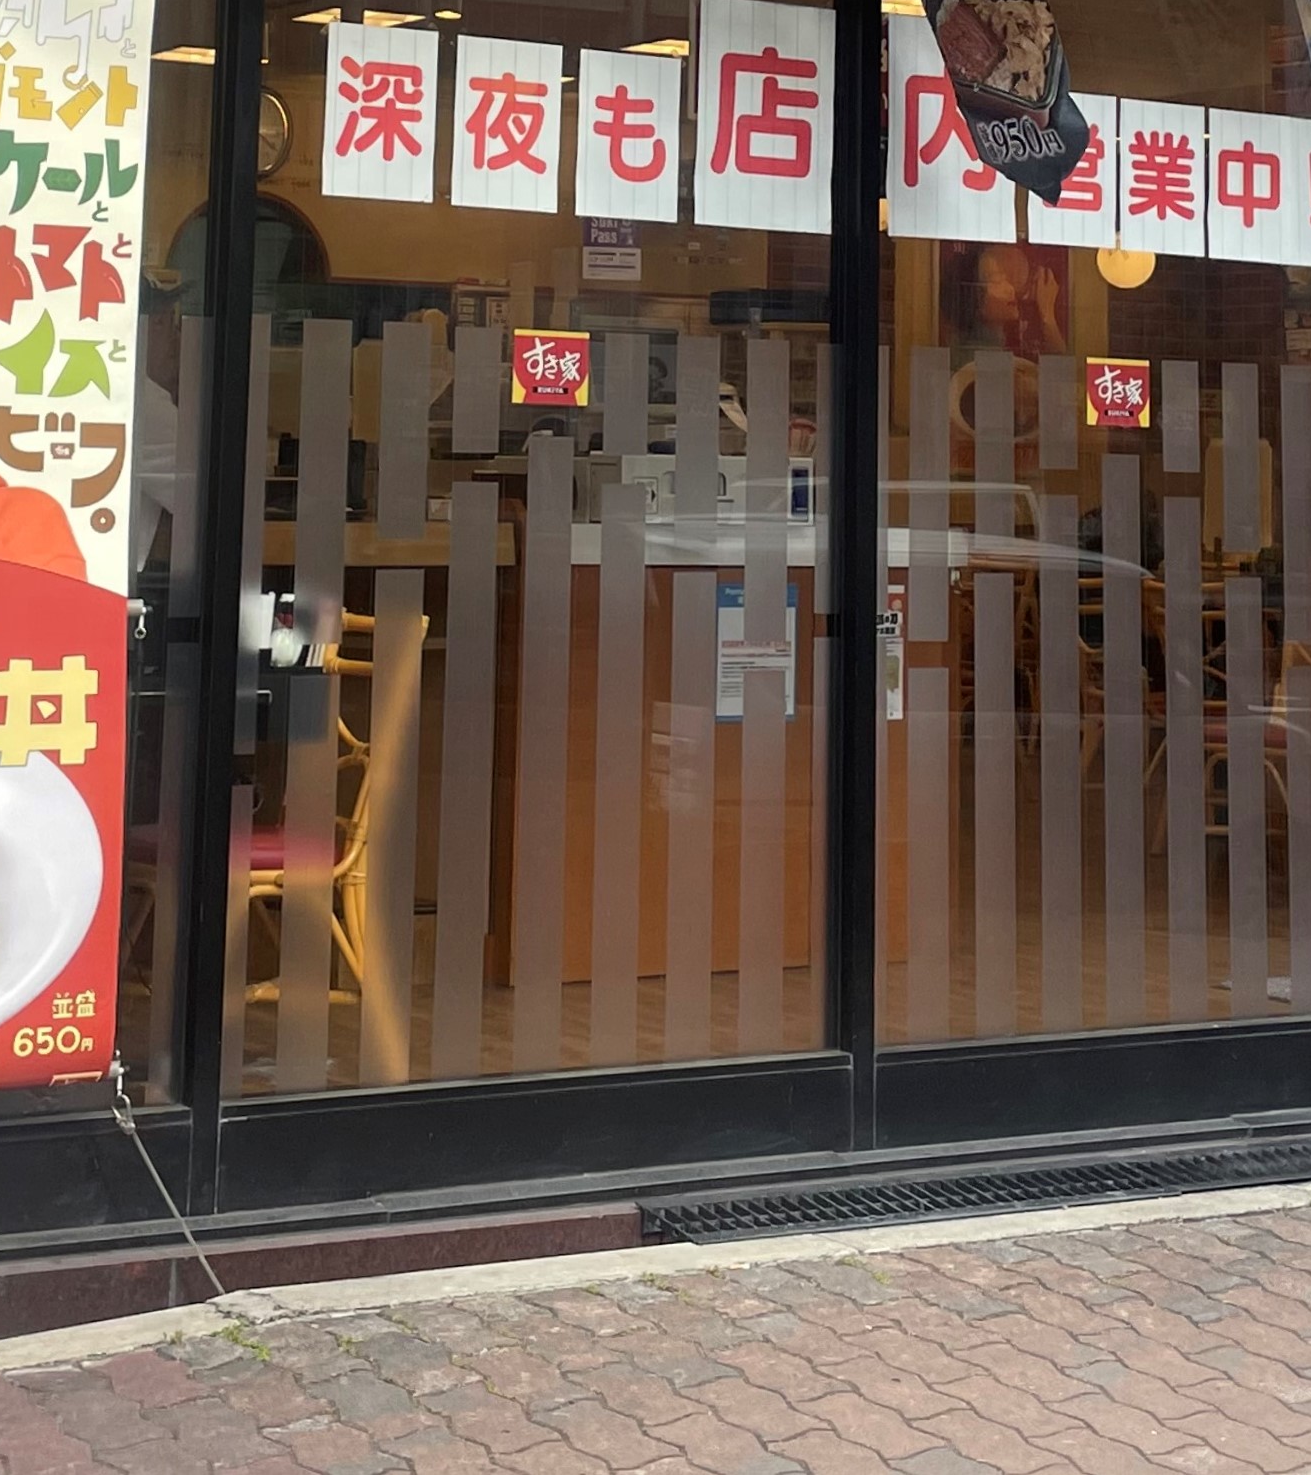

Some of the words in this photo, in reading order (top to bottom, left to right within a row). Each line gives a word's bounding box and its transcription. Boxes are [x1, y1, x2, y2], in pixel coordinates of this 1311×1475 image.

[591, 228, 617, 244] Pass
[522, 337, 581, 386] すき家
[1094, 365, 1143, 409] すき家
[52, 989, 96, 1019] 並盛
[13, 1025, 94, 1058] 650円
